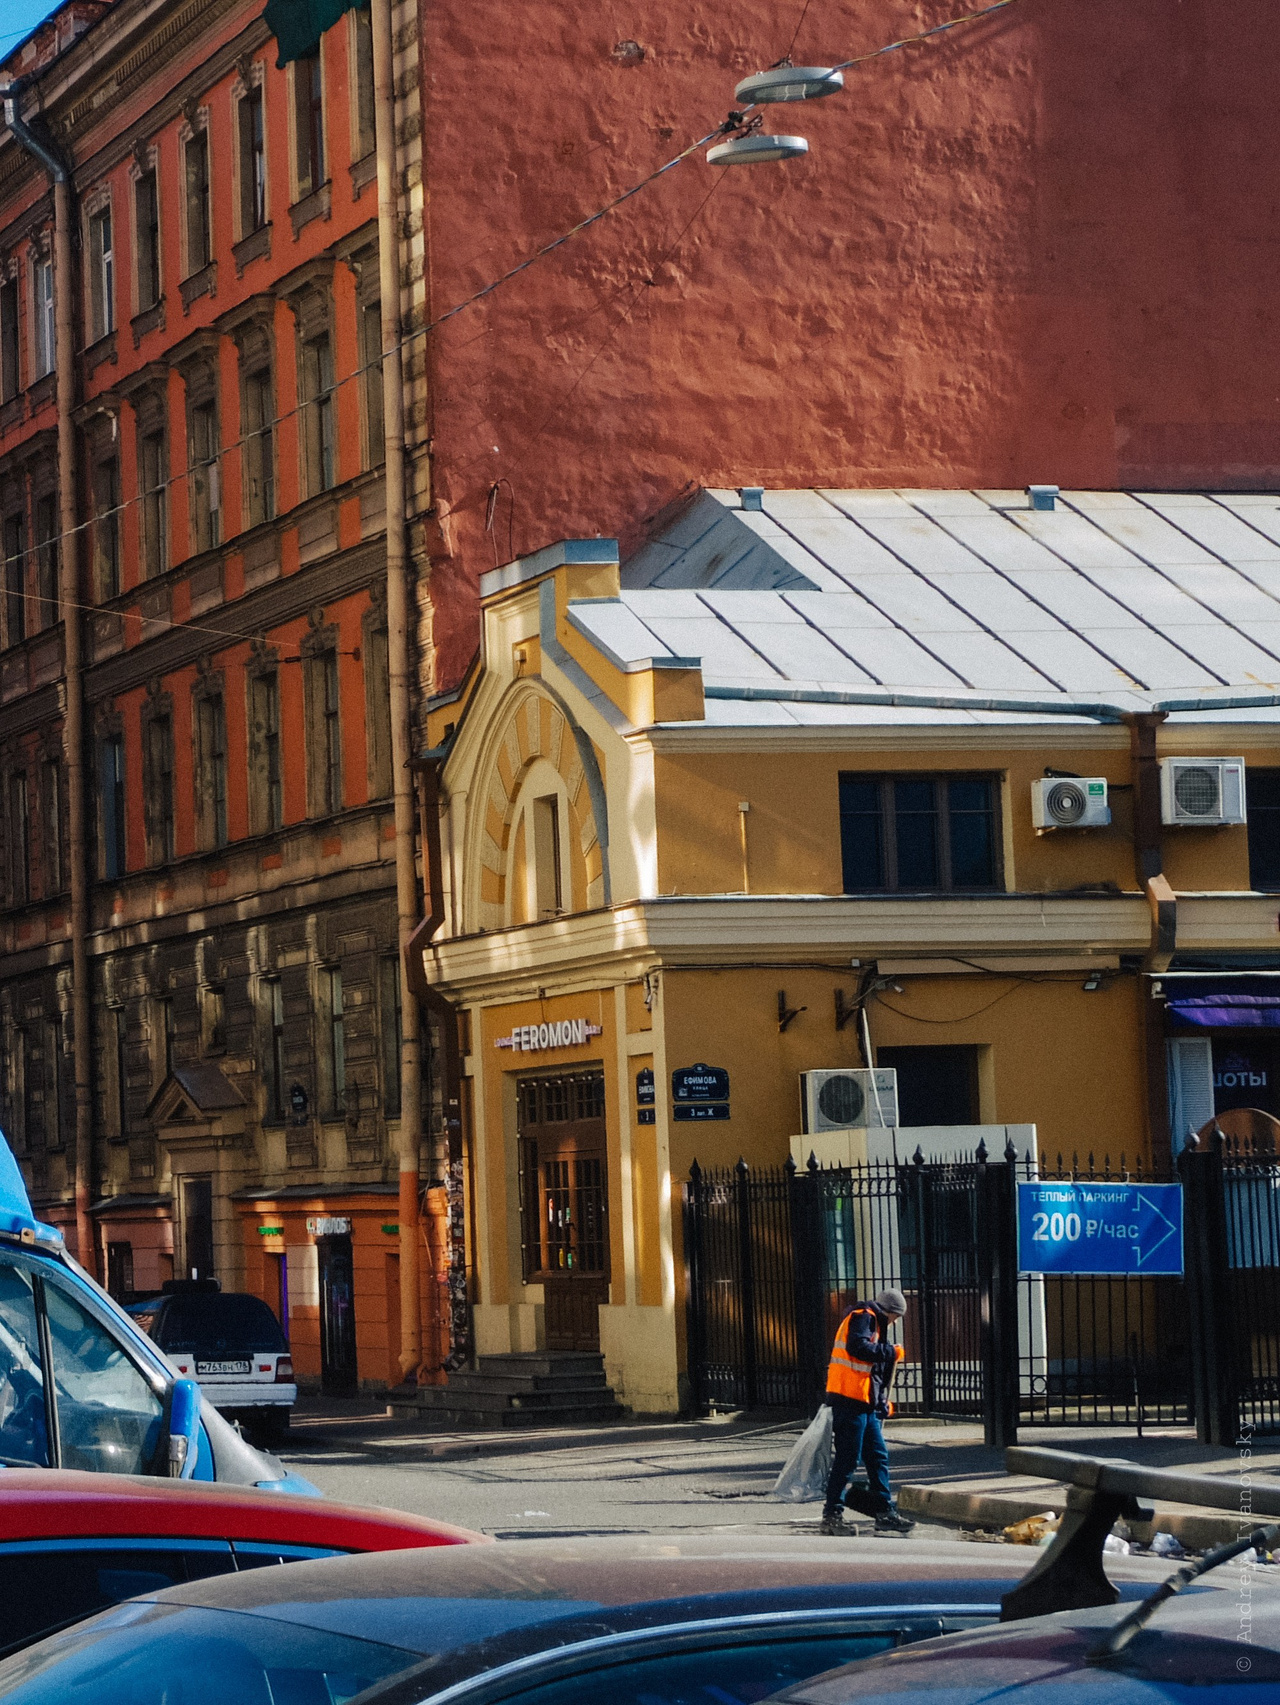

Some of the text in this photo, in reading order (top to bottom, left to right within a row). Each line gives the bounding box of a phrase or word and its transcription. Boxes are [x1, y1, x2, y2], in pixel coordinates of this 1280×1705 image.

[512, 1019, 583, 1051] FEROMON
[690, 1108, 696, 1117] 3
[1031, 1190, 1130, 1203] ТЕПЛЫЙ ПАРКИНГ
[1032, 1212, 1081, 1241] 200
